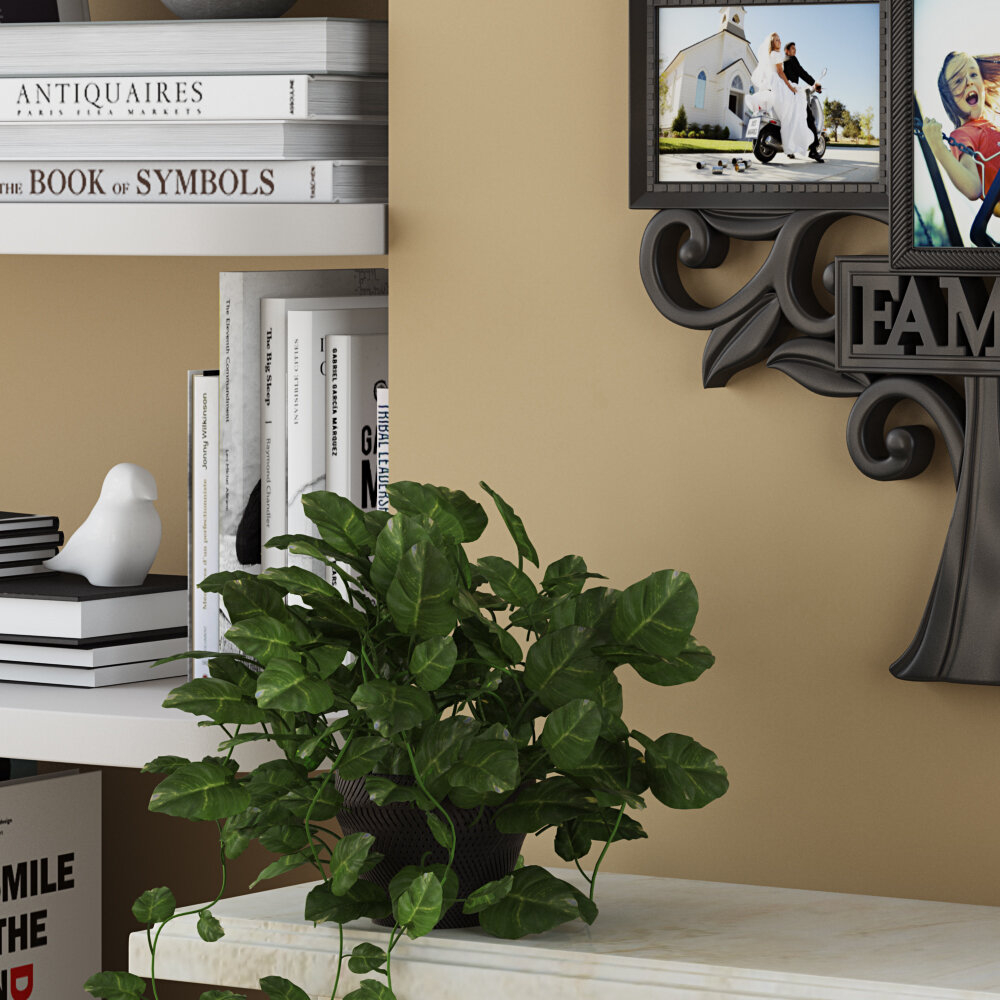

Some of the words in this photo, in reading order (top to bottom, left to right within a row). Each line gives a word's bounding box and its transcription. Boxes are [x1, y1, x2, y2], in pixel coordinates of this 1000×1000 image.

[17, 81, 203, 109] ANTIQUAIRES
[127, 108, 202, 116] MARKETS
[29, 169, 106, 196] BOOK
[112, 182, 130, 195] OF
[136, 168, 275, 196] SYMBOLS
[264, 352, 272, 373] Big
[264, 375, 272, 407] Sleep
[0, 852, 74, 903] MILE
